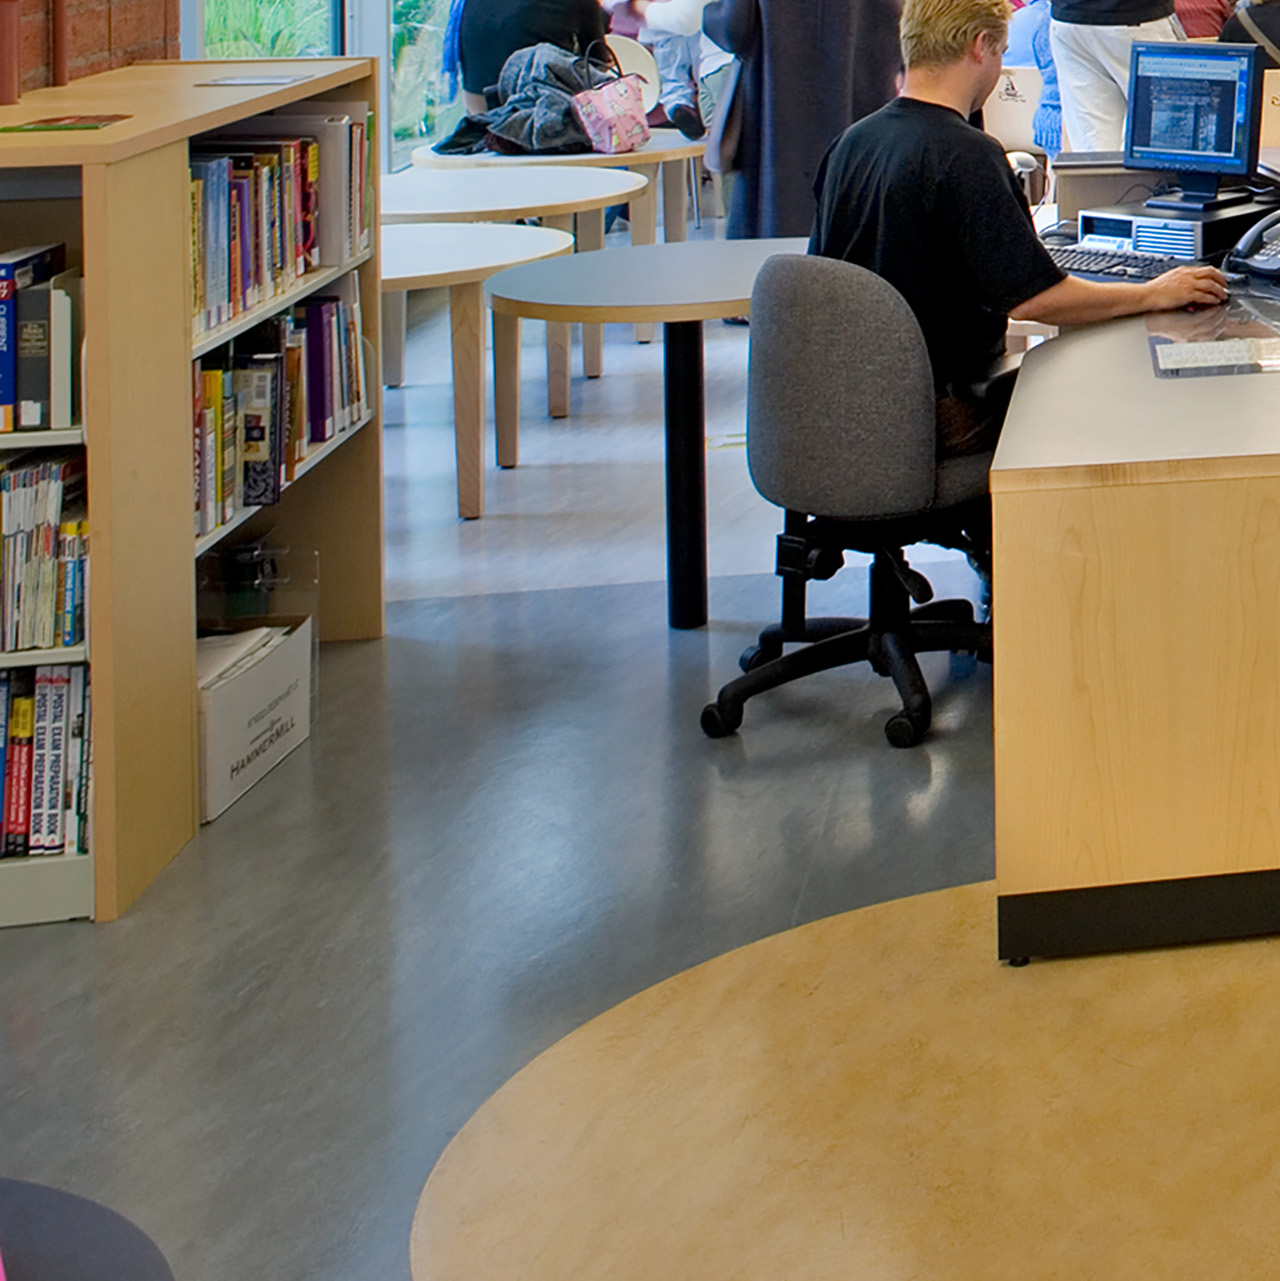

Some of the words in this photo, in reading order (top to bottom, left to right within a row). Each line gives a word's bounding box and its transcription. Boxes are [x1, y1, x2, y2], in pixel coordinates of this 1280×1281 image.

[35, 693, 49, 724] POSTAL
[52, 693, 64, 724] POSTAL
[34, 725, 47, 751] EXAM
[50, 726, 63, 751] EXAM
[33, 753, 46, 810] PREPARATION
[48, 753, 62, 810] PREPARATION
[32, 812, 44, 835] BOOK
[46, 812, 59, 835] BOOK
